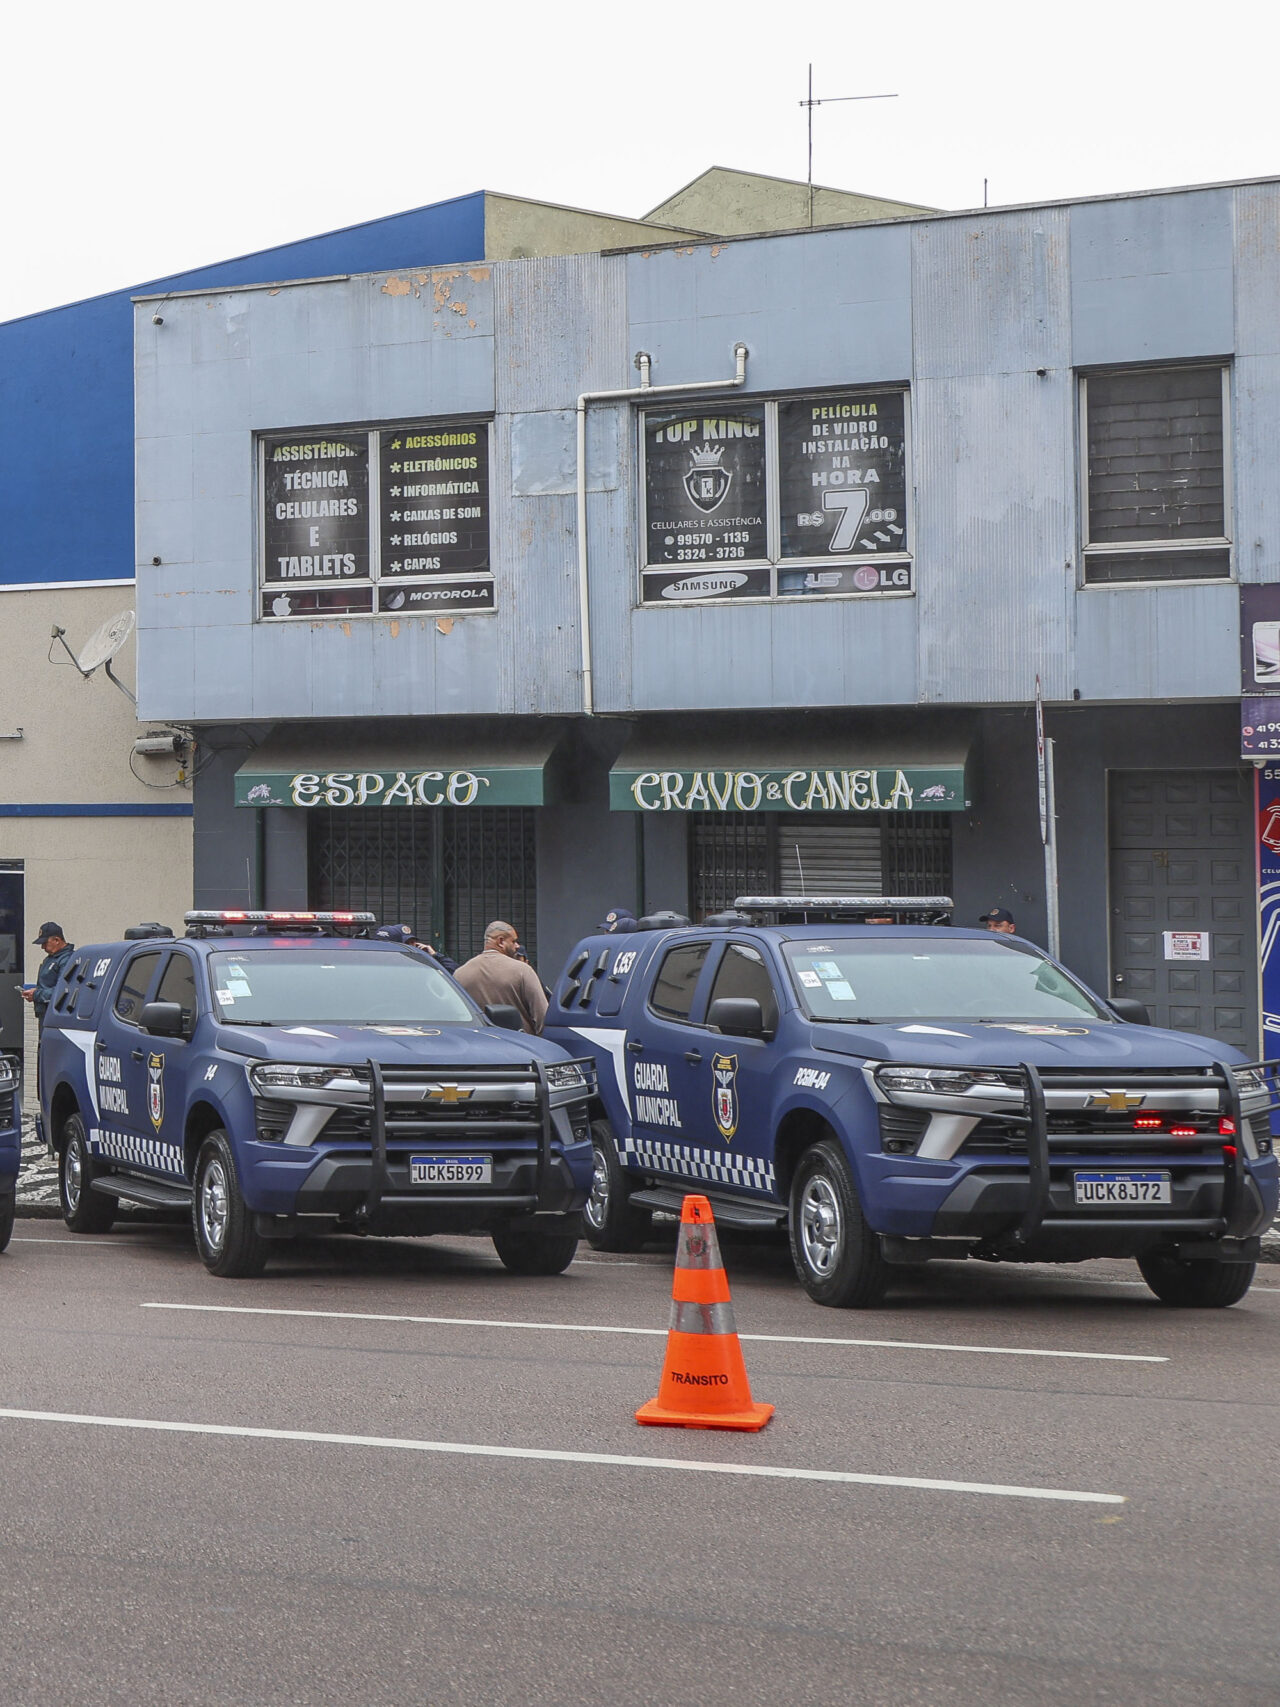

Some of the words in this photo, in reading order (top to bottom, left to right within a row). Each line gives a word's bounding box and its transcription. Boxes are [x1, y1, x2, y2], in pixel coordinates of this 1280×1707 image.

[812, 403, 878, 420] PELÍCULA
[702, 419, 760, 440] KING
[812, 423, 829, 437] DE
[833, 420, 877, 435] VIDRO
[405, 432, 477, 449] ACESSÓRIOS
[802, 434, 889, 454] INSTALAÇÃO
[273, 440, 358, 462] ASSISTÊNCI
[403, 456, 478, 473] ELETRÔNICOS
[832, 455, 850, 469] NA
[284, 469, 349, 490] TÉCNICA
[811, 468, 880, 487] HORA
[403, 480, 480, 498] INFORMÁTICA
[275, 498, 358, 520] CELULARES
[403, 509, 441, 522] CAIXAS
[442, 508, 456, 520] DE
[457, 506, 481, 519] SOM
[651, 520, 699, 530] CELULARES
[700, 519, 706, 527] E
[707, 516, 762, 527] ASSISTÊNCIA
[309, 526, 320, 547] E
[403, 531, 458, 546] RELÓGIOS
[677, 533, 713, 546] 99570
[723, 531, 750, 544] 1135
[677, 548, 706, 560] 3324
[716, 546, 745, 559] 3736
[278, 553, 356, 578] TABLETS
[404, 557, 441, 571] CAPAS
[673, 580, 737, 592] SAMSUNG
[880, 568, 909, 586] LG
[409, 588, 489, 601] MOTOROLA
[631, 770, 768, 811] CRAVO
[766, 781, 783, 800] &
[782, 769, 914, 811] CANELA
[98, 1055, 122, 1083] GUARDA
[634, 1061, 669, 1093] GUARDA
[99, 1084, 129, 1115] MUNICIPAL
[635, 1094, 682, 1128] MUNICIPAL
[417, 1165, 484, 1181] UCK5B99
[1083, 1183, 1162, 1201] UCK8J72
[671, 1371, 729, 1386] TRÂNSITO
